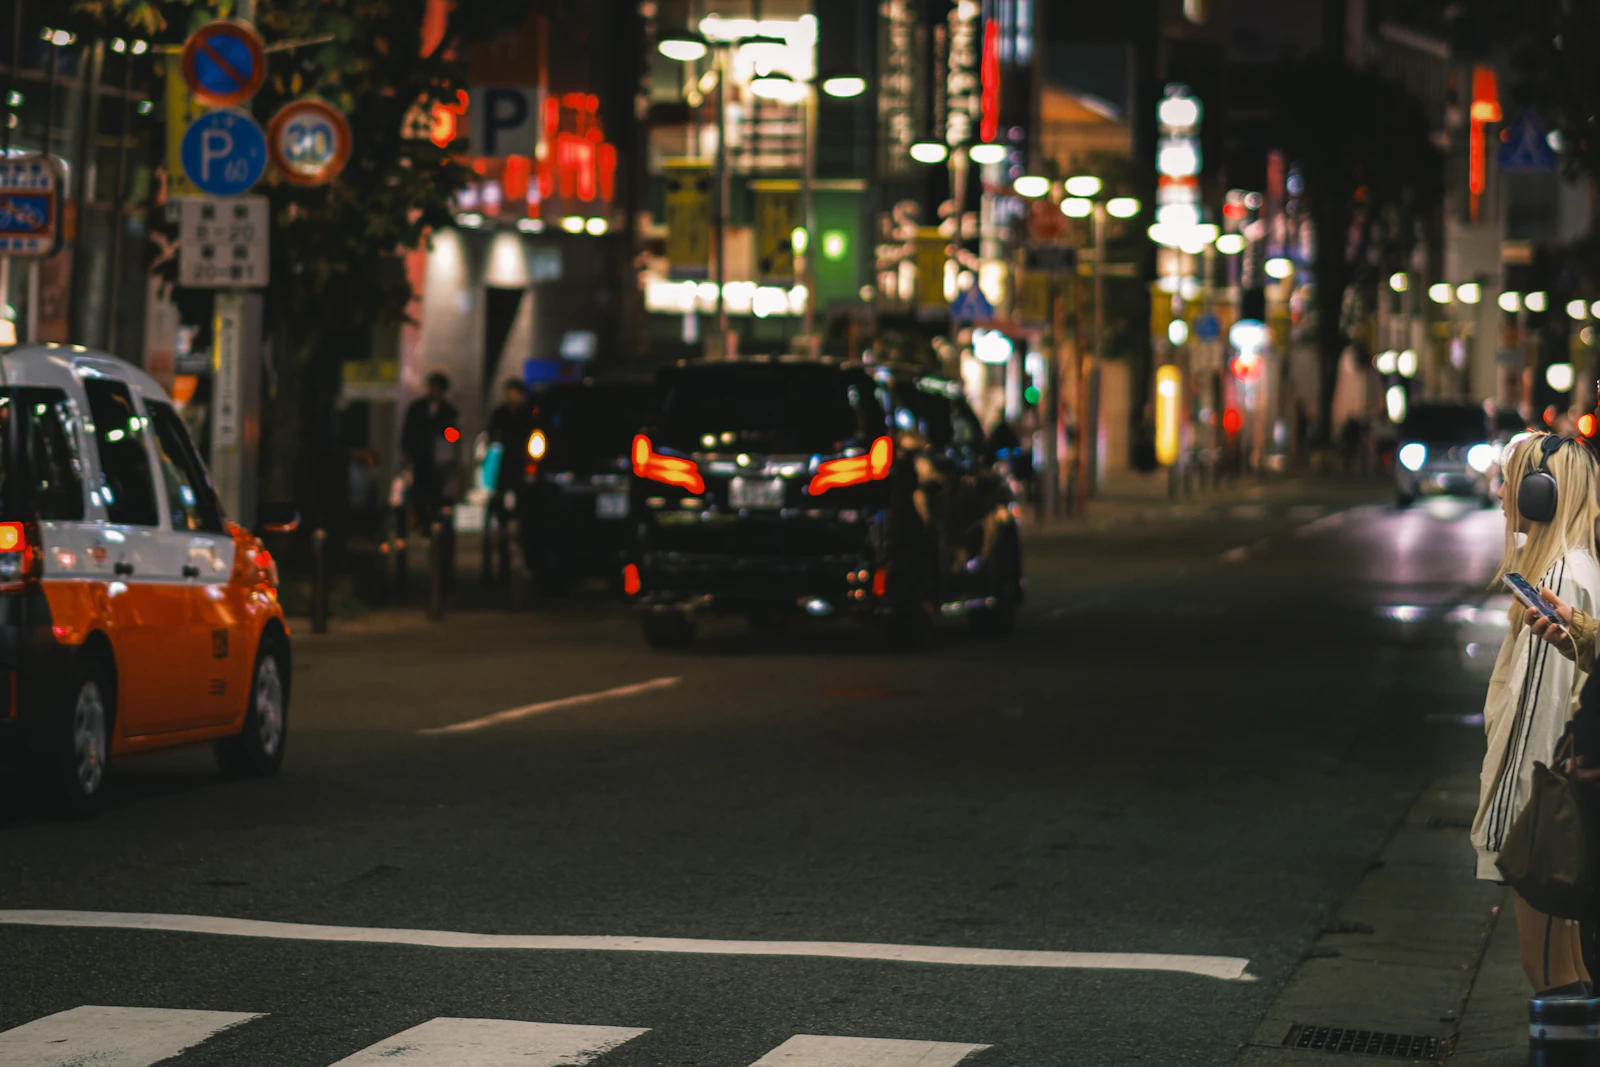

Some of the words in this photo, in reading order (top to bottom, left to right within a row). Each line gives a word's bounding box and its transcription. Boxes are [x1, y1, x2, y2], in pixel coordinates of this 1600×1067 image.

[484, 88, 529, 154] P
[202, 129, 233, 182] P
[224, 159, 249, 182] 60
